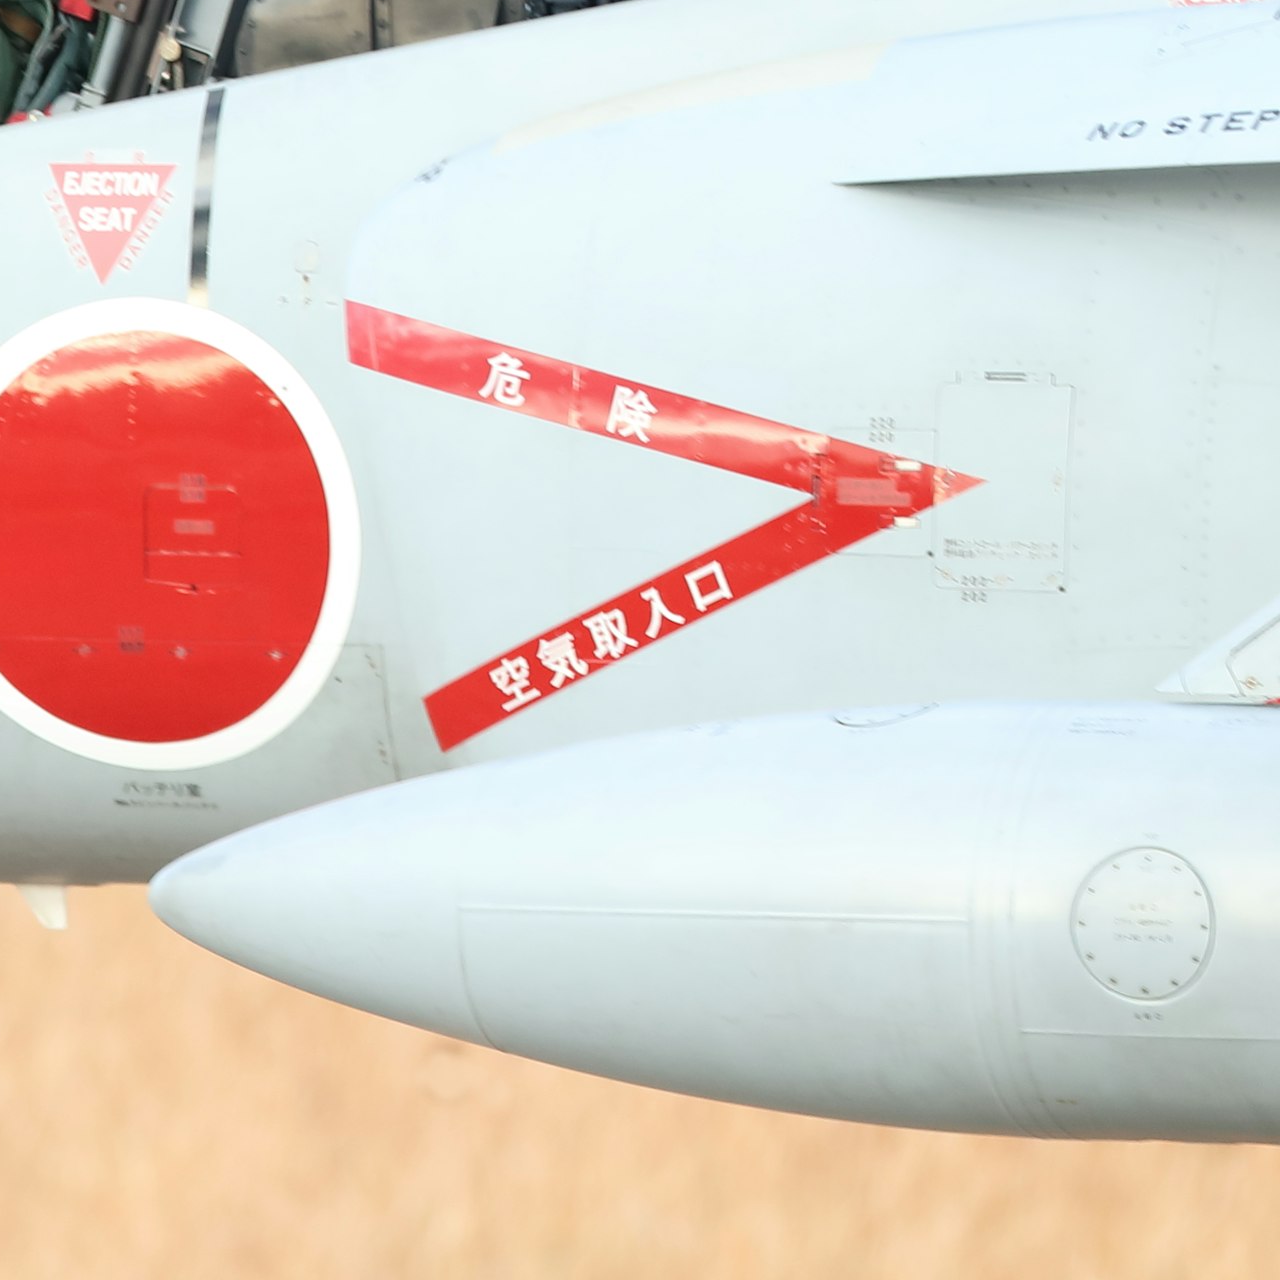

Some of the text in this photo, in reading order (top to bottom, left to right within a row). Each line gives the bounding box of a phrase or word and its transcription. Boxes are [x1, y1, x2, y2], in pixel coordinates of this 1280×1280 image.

[1086, 120, 1147, 142] NO
[62, 170, 160, 197] EJECTION
[77, 206, 138, 233] SEAT
[477, 350, 660, 445] 危険
[488, 560, 734, 713] 空気取入口
